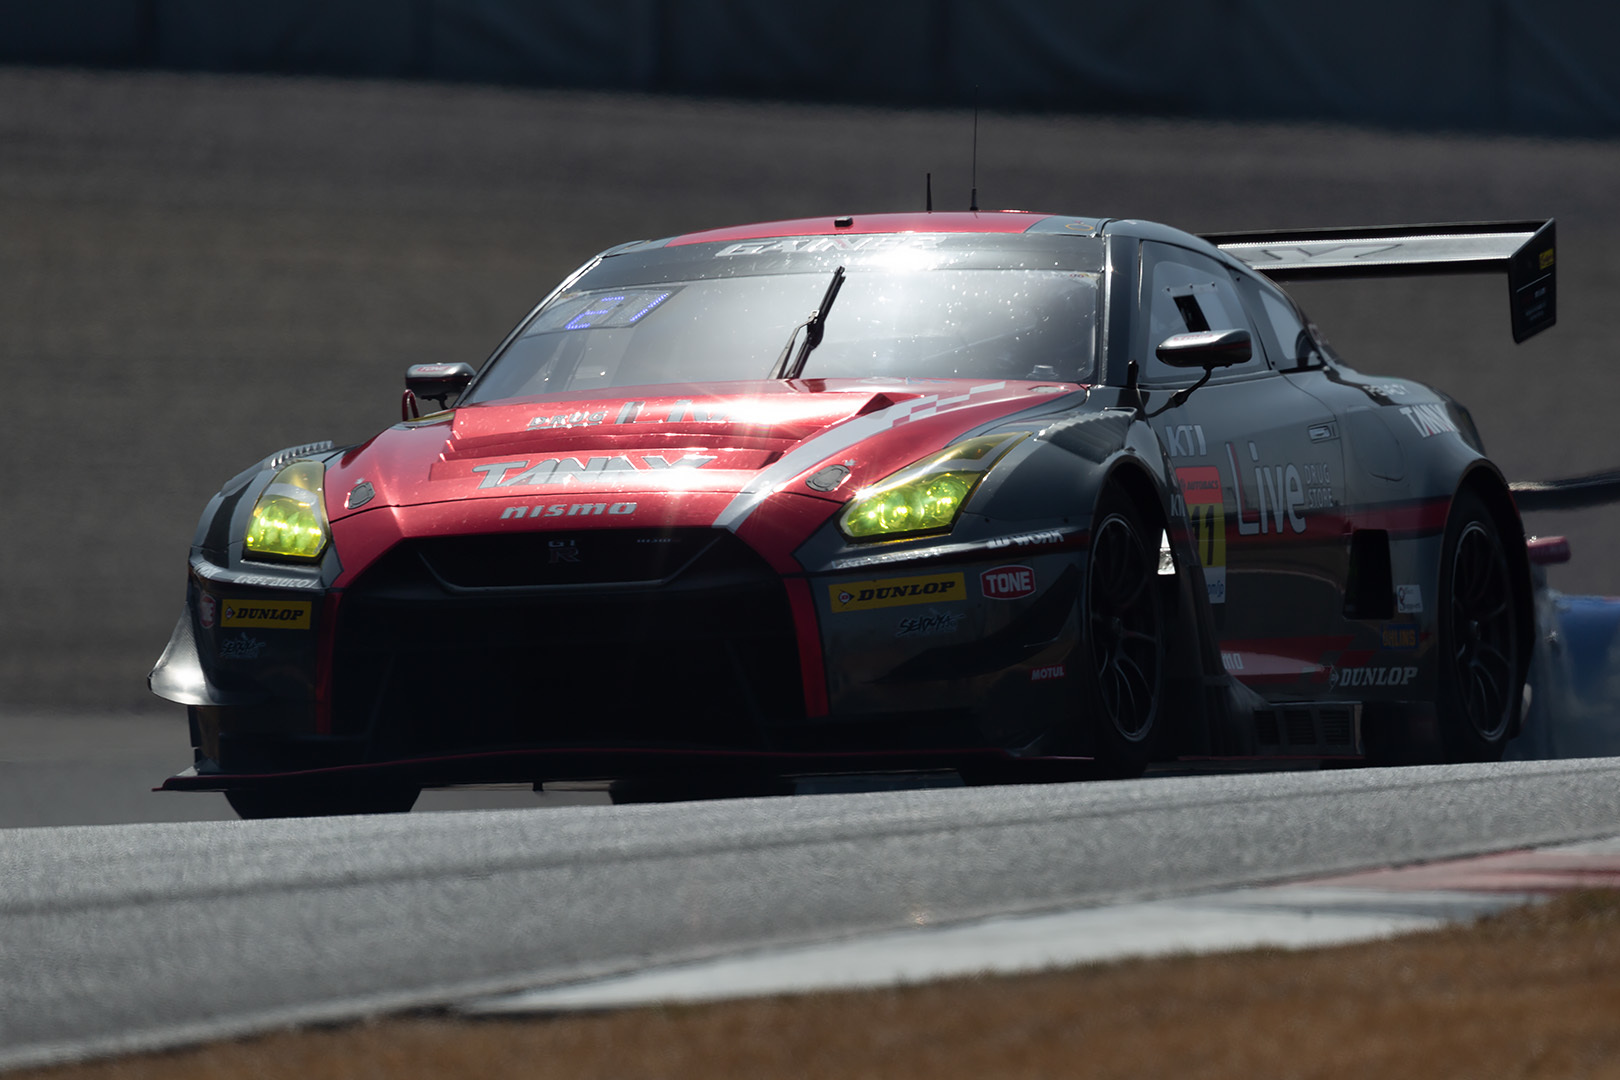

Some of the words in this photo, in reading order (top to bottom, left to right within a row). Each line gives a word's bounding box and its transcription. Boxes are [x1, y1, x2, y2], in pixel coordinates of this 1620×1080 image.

[528, 411, 606, 427] DRUG
[1304, 463, 1331, 485] DRUG
[1225, 441, 1307, 536] Live
[1307, 487, 1334, 509] STORE
[857, 581, 956, 601] DUNLOP
[985, 571, 1032, 595] TONE
[236, 607, 304, 621] DUNLOP
[1031, 665, 1064, 680] MOTUL
[1339, 666, 1418, 687] DUNLOP
